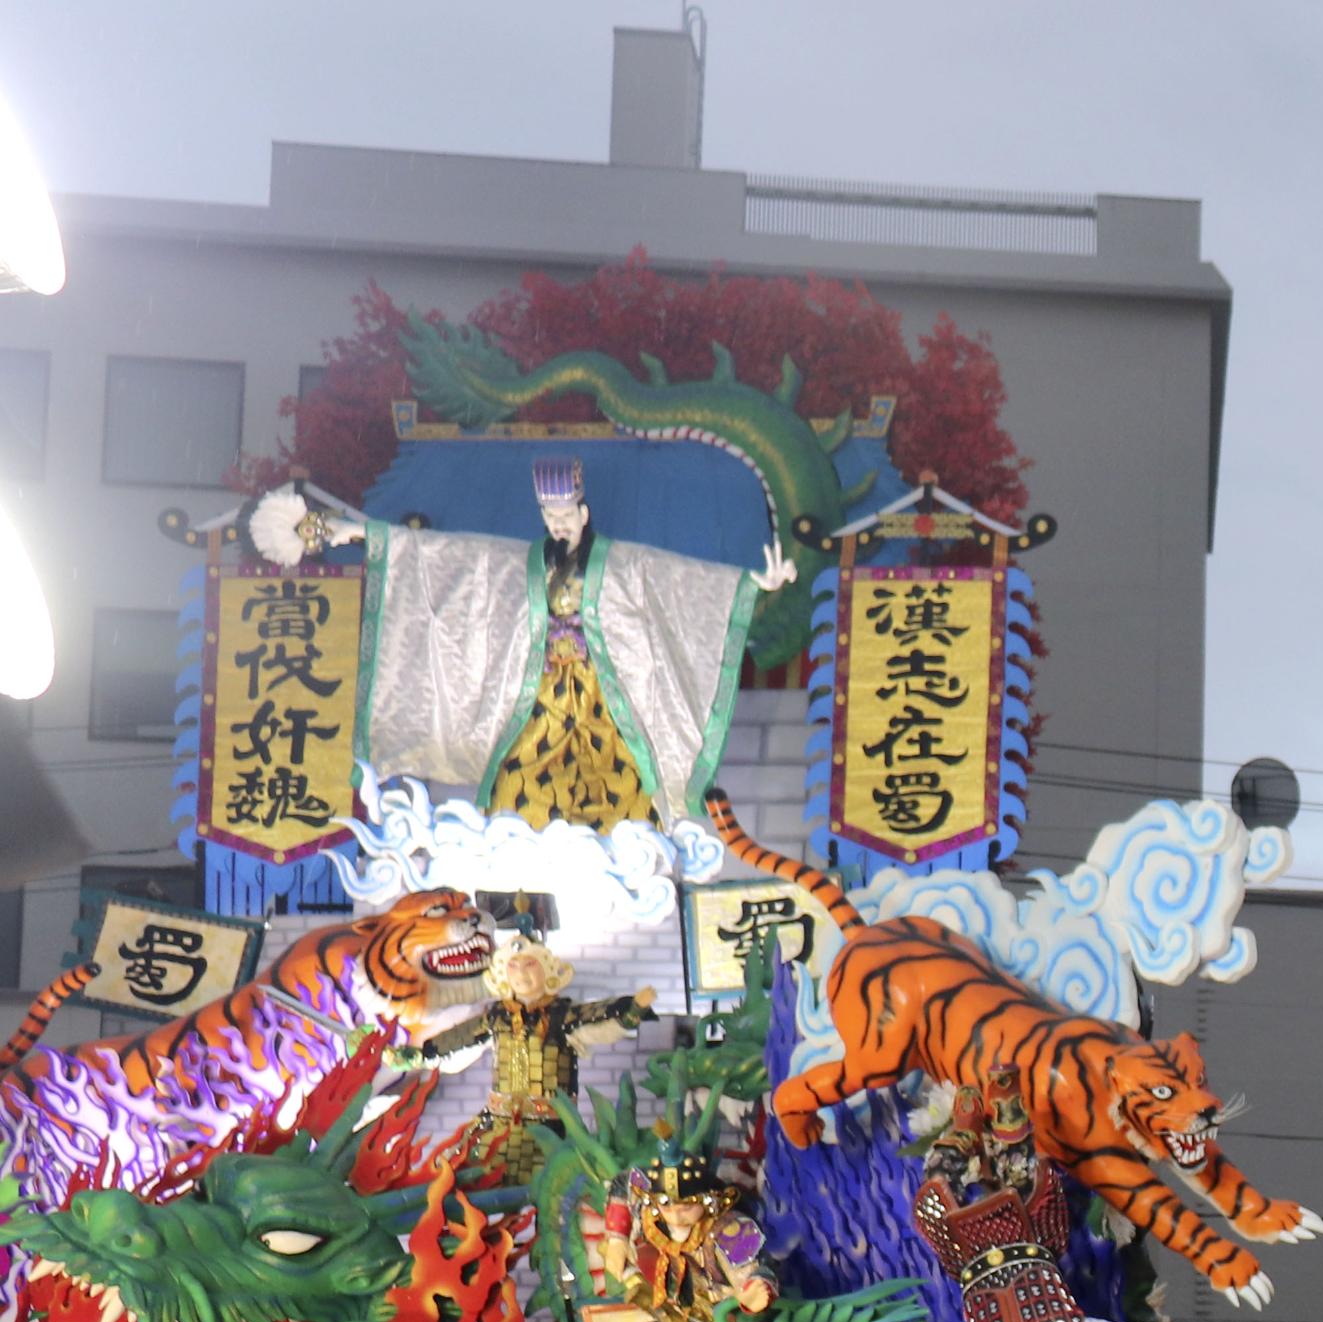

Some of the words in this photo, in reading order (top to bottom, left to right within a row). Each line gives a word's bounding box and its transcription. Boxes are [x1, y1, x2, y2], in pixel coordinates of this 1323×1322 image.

[862, 582, 970, 835] 漢志在蜀
[118, 924, 208, 1006] 蜀
